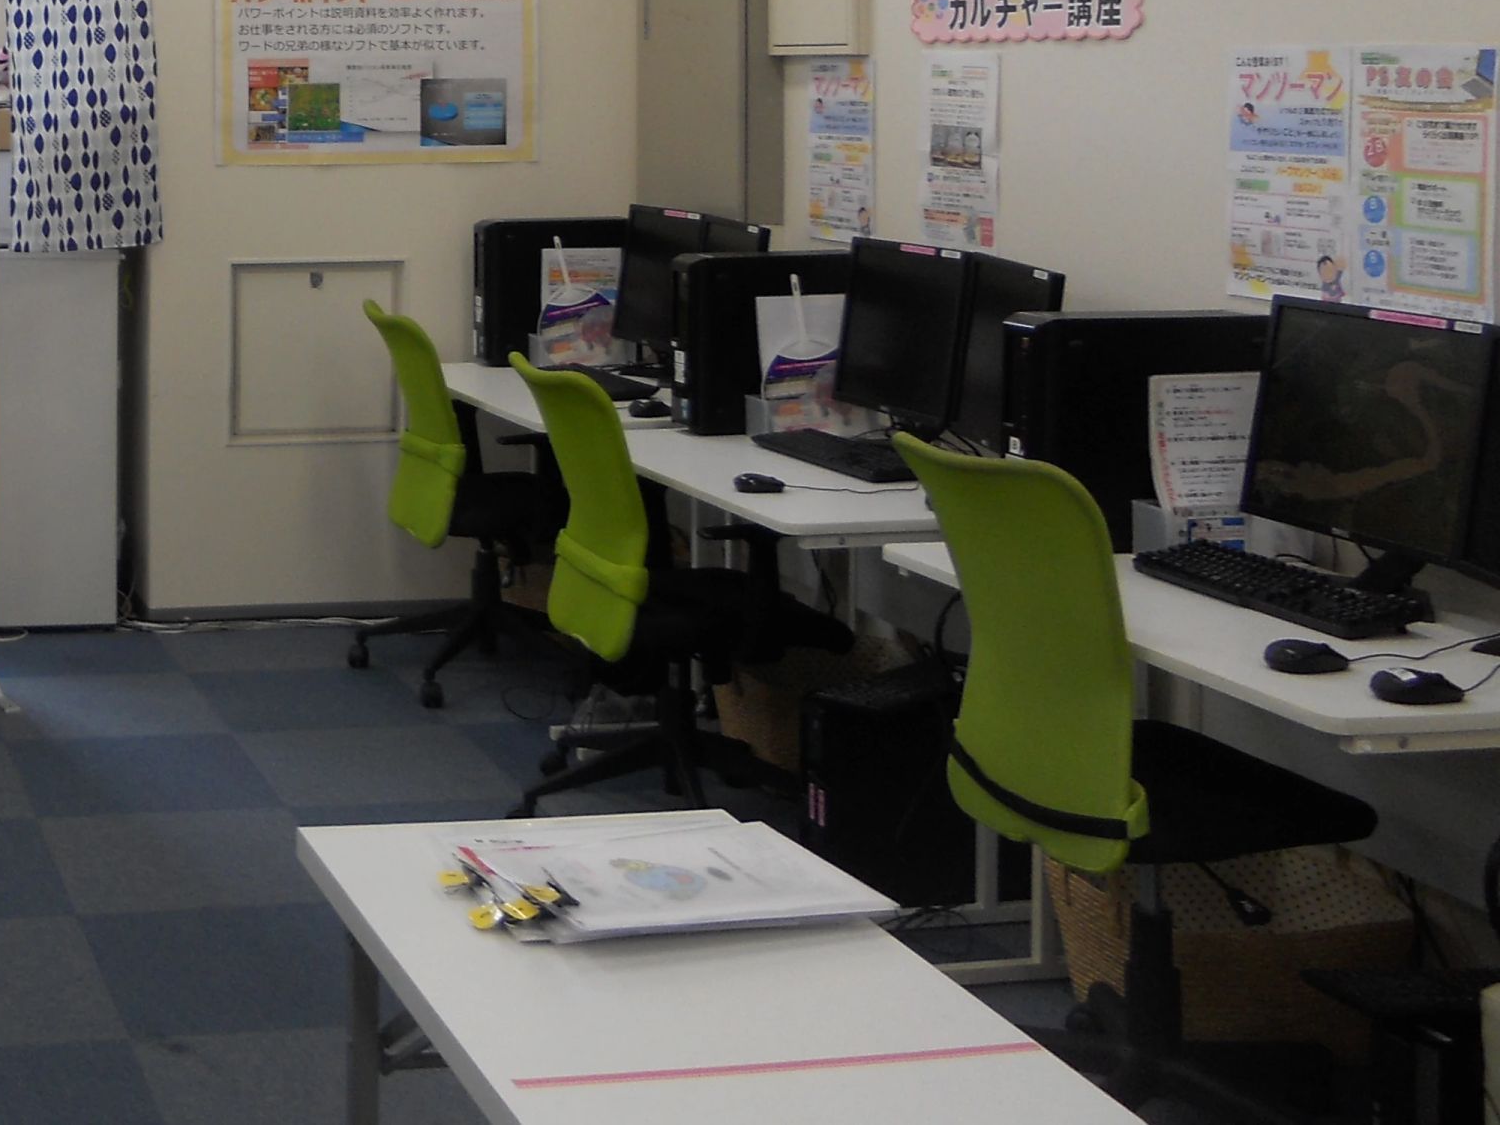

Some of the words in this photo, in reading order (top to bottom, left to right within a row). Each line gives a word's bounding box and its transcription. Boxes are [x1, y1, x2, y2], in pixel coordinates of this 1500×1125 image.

[1239, 72, 1344, 101] マンツーマン
